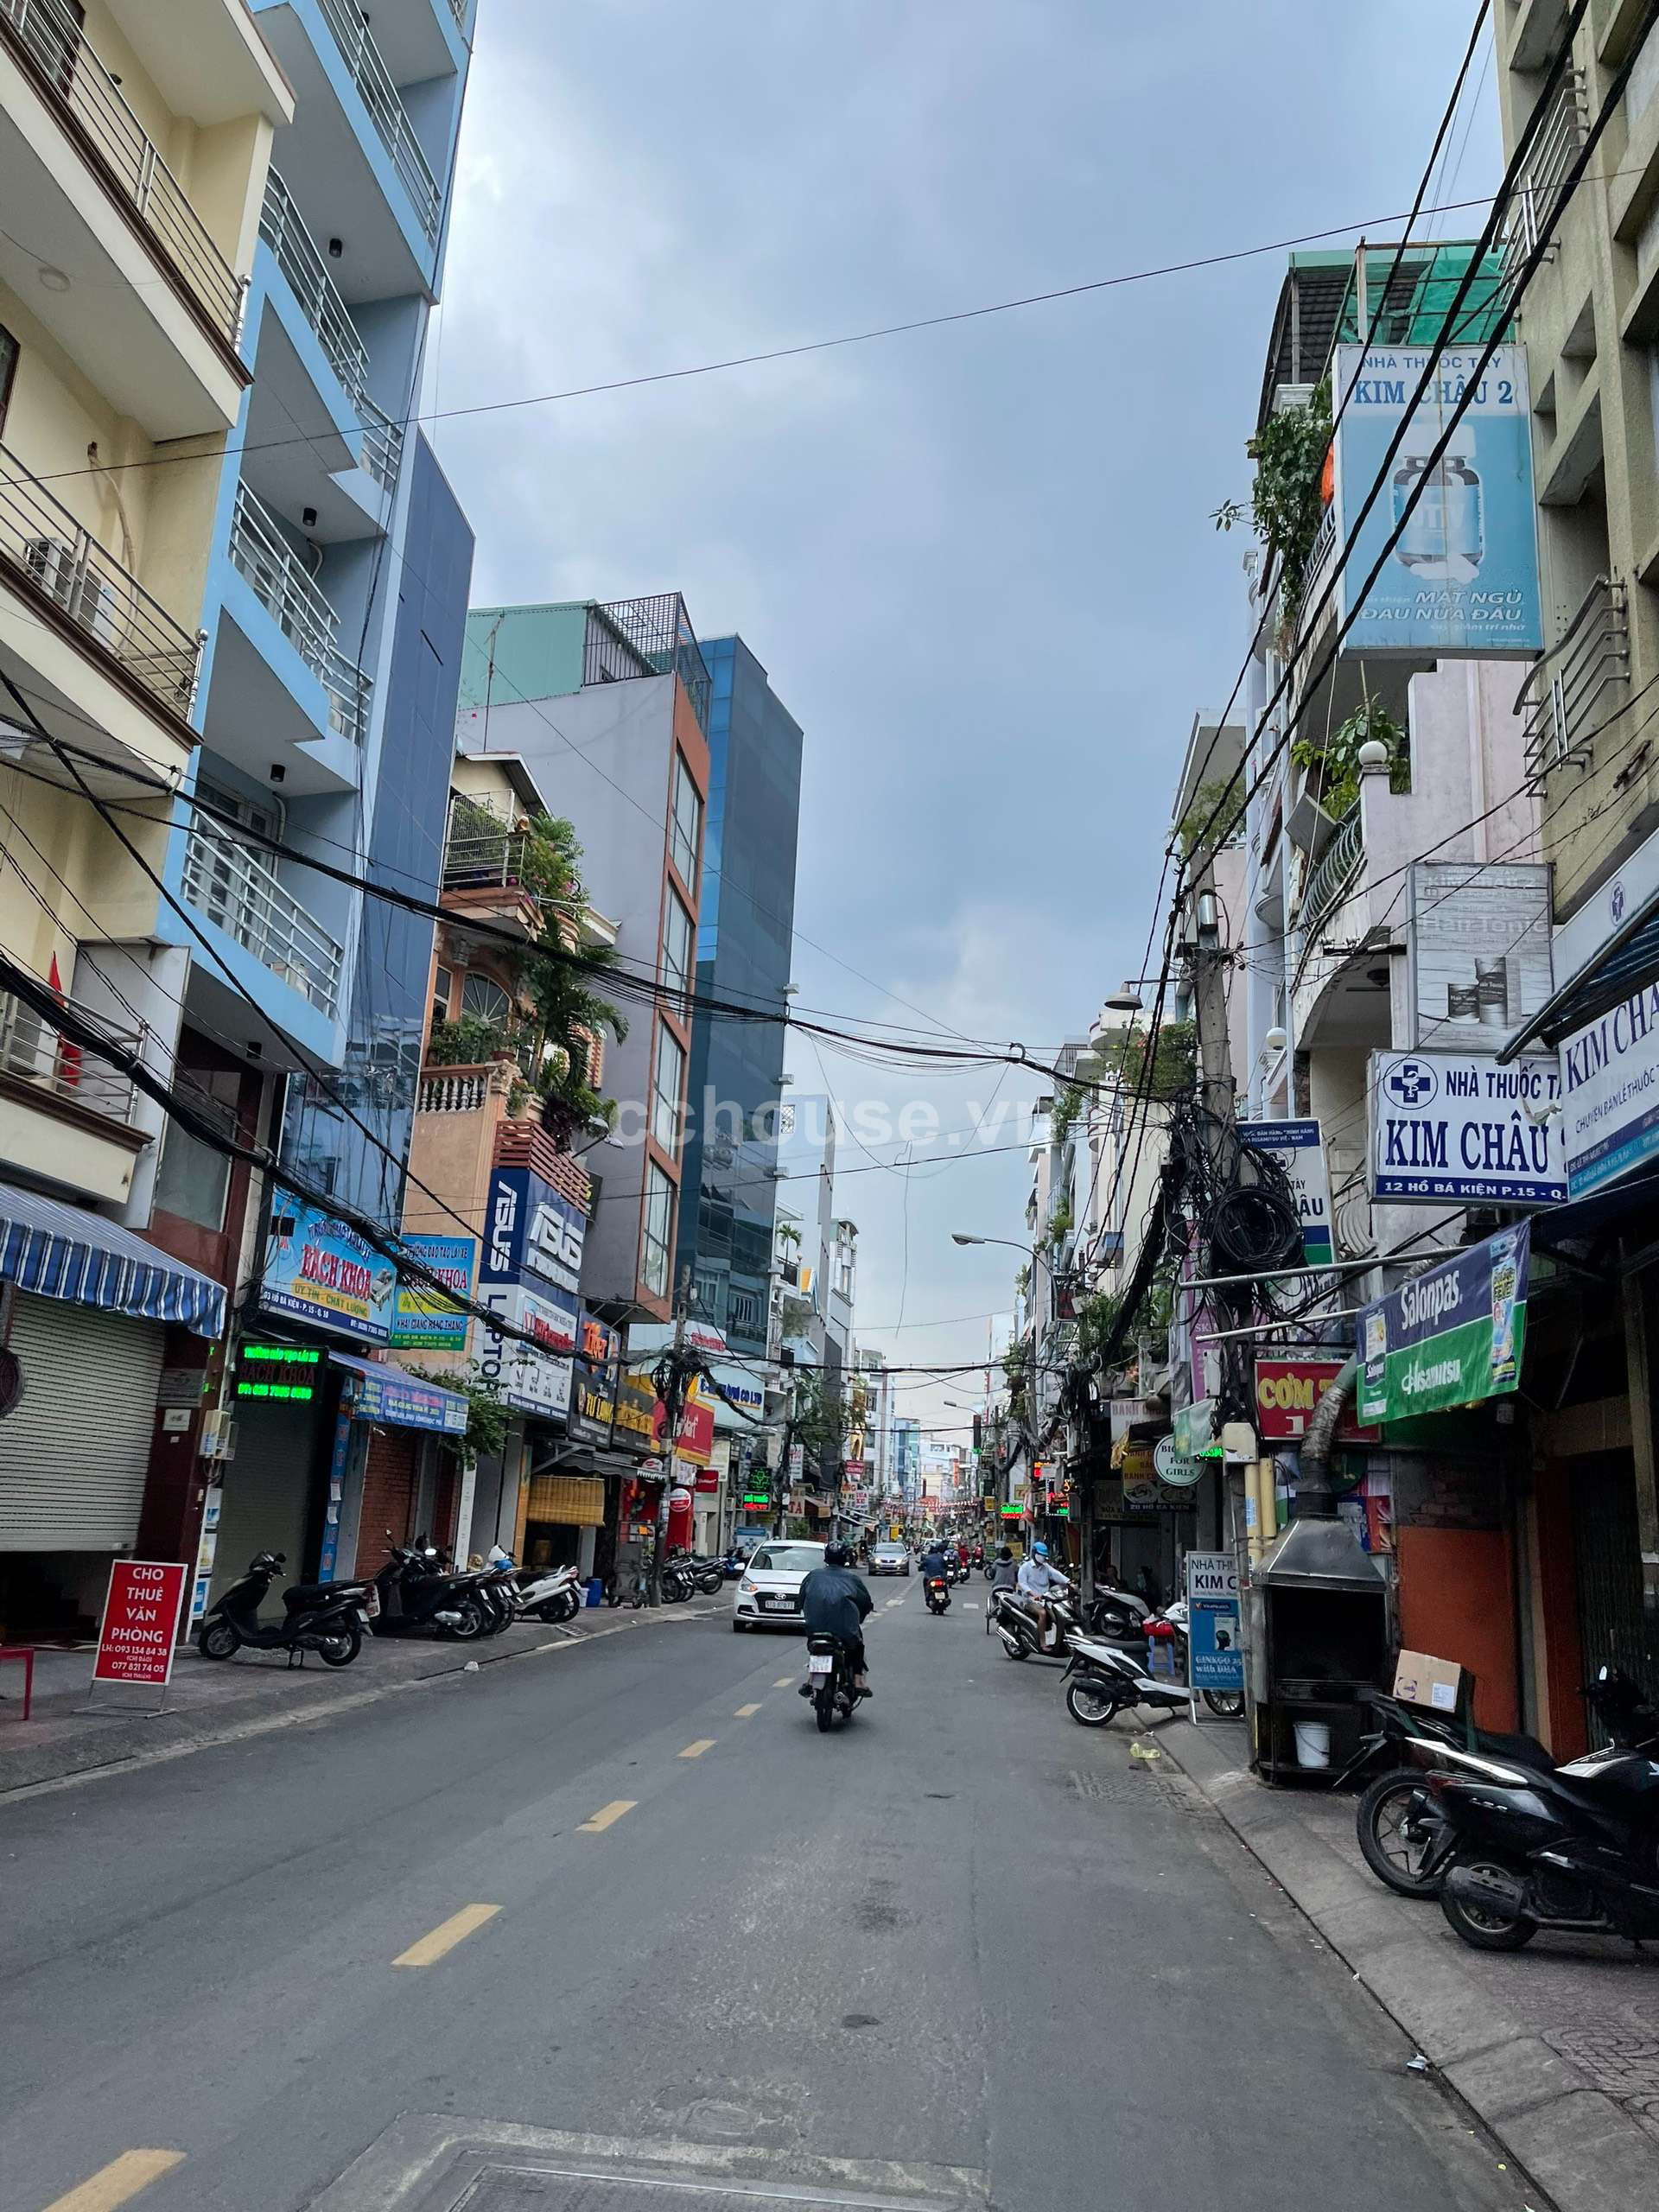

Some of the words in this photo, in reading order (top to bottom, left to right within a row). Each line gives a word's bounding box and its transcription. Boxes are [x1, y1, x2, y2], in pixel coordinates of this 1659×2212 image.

[1363, 353, 1397, 369] NHÀ
[1402, 353, 1463, 369] THỐC
[1468, 354, 1502, 369] TY
[1354, 380, 1406, 404] KIM
[1497, 379, 1514, 404] 2
[1566, 1018, 1610, 1094] KIM
[1446, 1065, 1479, 1098] NHÀ
[1485, 1063, 1541, 1100] THUỐC
[1385, 1119, 1449, 1169] KIM
[1460, 1109, 1549, 1174] CHÂU
[1384, 1182, 1403, 1192] 12
[1408, 1179, 1429, 1192] HỒ
[1434, 1180, 1455, 1193] BÁ
[1460, 1183, 1497, 1196] KIỆN
[1502, 1185, 1535, 1197] P.15
[490, 1175, 518, 1272] ASUS
[339, 1258, 372, 1301] KHOA
[481, 1294, 507, 1391] LPTOP
[1258, 1372, 1315, 1410] CƠM
[1166, 1467, 1195, 1477] GIRLS
[1192, 1557, 1216, 1571] NHÀ
[132, 1567, 164, 1581] CHO
[1195, 1574, 1224, 1590] KIM
[126, 1586, 164, 1602] THUÊ
[126, 1605, 157, 1622] VĂN
[111, 1625, 164, 1643] PHÒNG
[101, 1643, 114, 1652] LH:
[114, 1644, 130, 1654] 093
[131, 1646, 144, 1655] 134
[111, 1661, 128, 1670] 077
[142, 1663, 153, 1672] 74
[153, 1664, 165, 1673] 05
[1195, 1655, 1231, 1665] GINKGO
[1196, 1663, 1216, 1674] with
[1216, 1665, 1237, 1674] DHA
